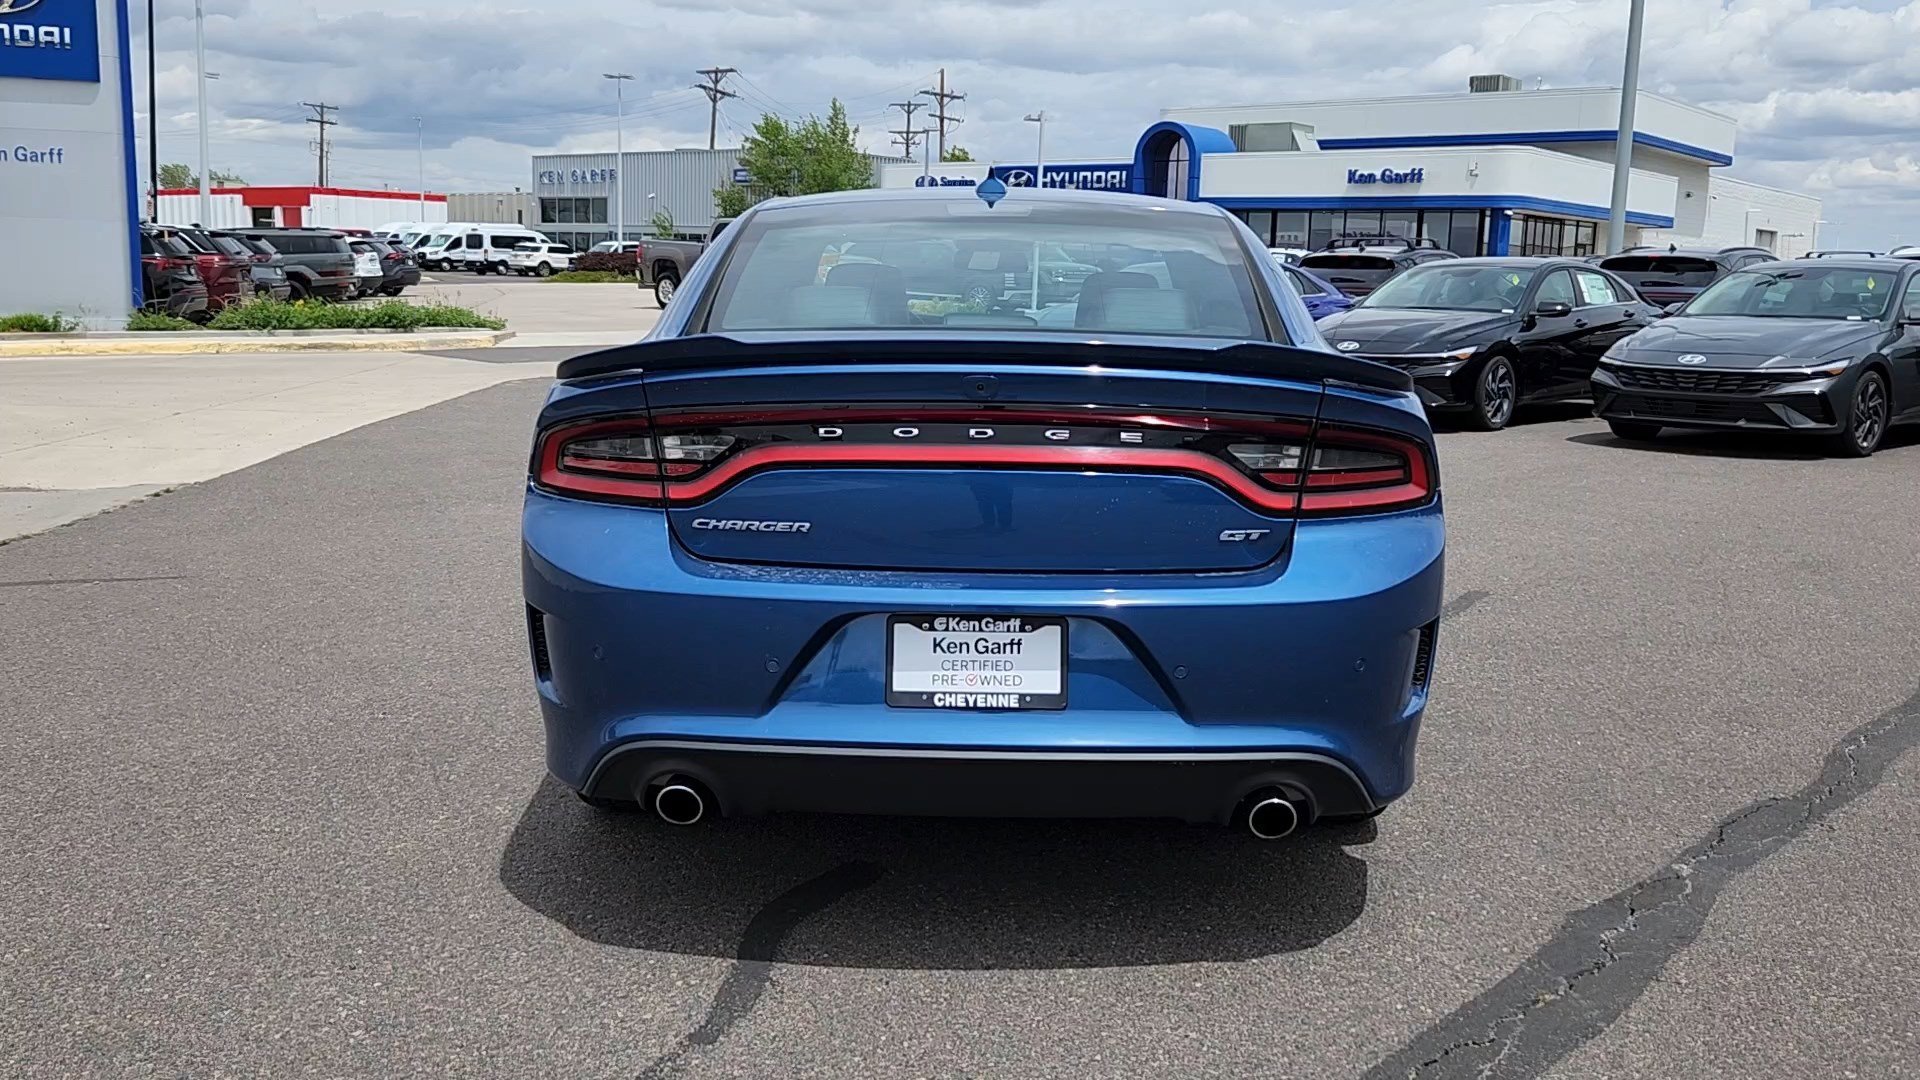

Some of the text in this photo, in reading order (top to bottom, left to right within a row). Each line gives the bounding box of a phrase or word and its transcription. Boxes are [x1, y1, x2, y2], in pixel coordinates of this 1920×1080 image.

[14, 146, 63, 164] Garff
[539, 170, 564, 184] KEN
[1042, 171, 1127, 189] HYUNDAI
[1347, 168, 1424, 184] Ken Garff
[818, 426, 1143, 443] DODGE
[691, 518, 812, 533] CHARGER
[1219, 529, 1270, 541] GT
[948, 617, 1021, 633] Ken Garff
[932, 637, 1023, 655] Ken Garff
[941, 659, 1014, 672] CERTIFIED
[933, 693, 1020, 708] CHEYENNE
